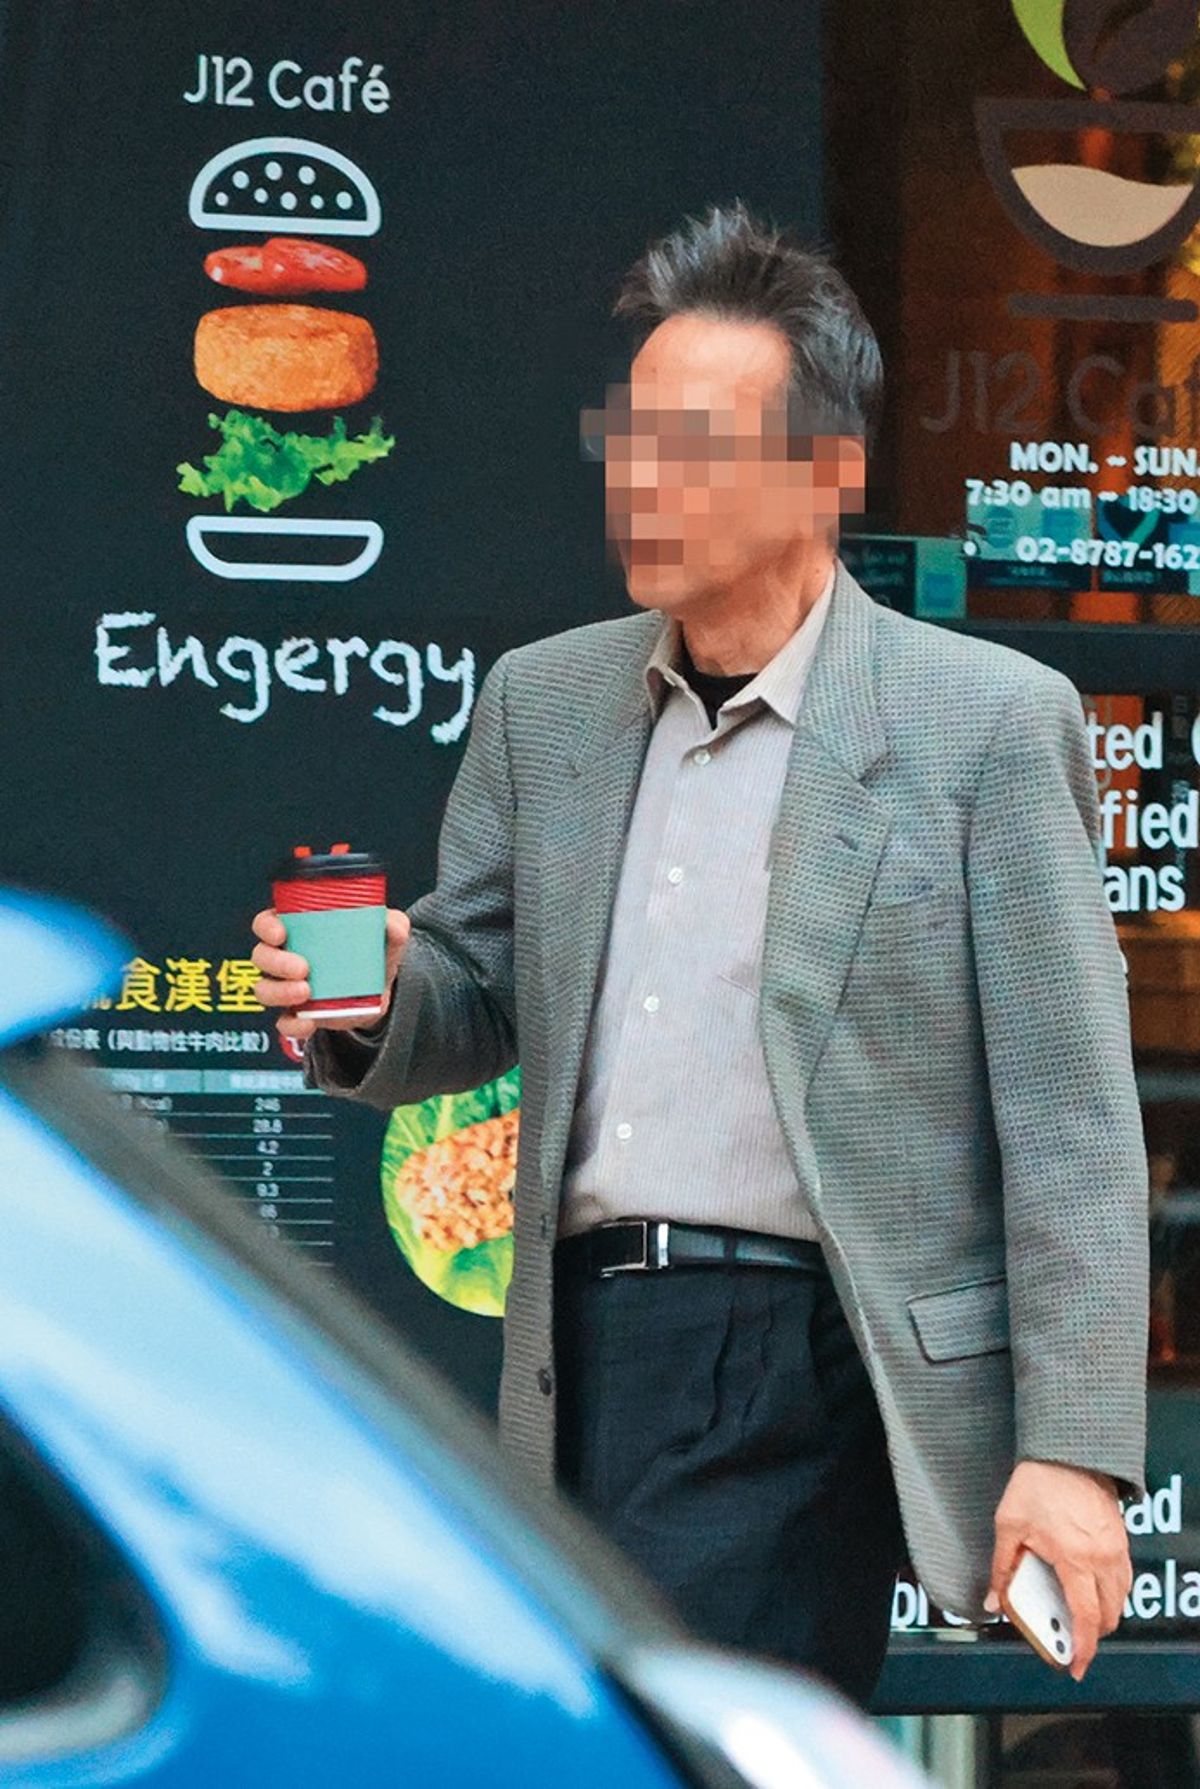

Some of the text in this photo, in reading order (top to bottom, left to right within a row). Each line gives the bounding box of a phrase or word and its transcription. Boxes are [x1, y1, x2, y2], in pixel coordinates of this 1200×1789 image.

[183, 54, 391, 113] J12 Café
[921, 350, 1041, 434] J12
[1010, 442, 1099, 473] MON.
[965, 479, 1032, 507] 7:30
[1040, 484, 1091, 509] am
[1127, 486, 1199, 514] 18:30
[95, 611, 475, 744] Engergy
[1087, 710, 1163, 769] ted
[1100, 790, 1199, 849] fied
[1105, 865, 1185, 912] ans
[92, 957, 266, 1012] 食漢堡
[1122, 1474, 1182, 1534] ad
